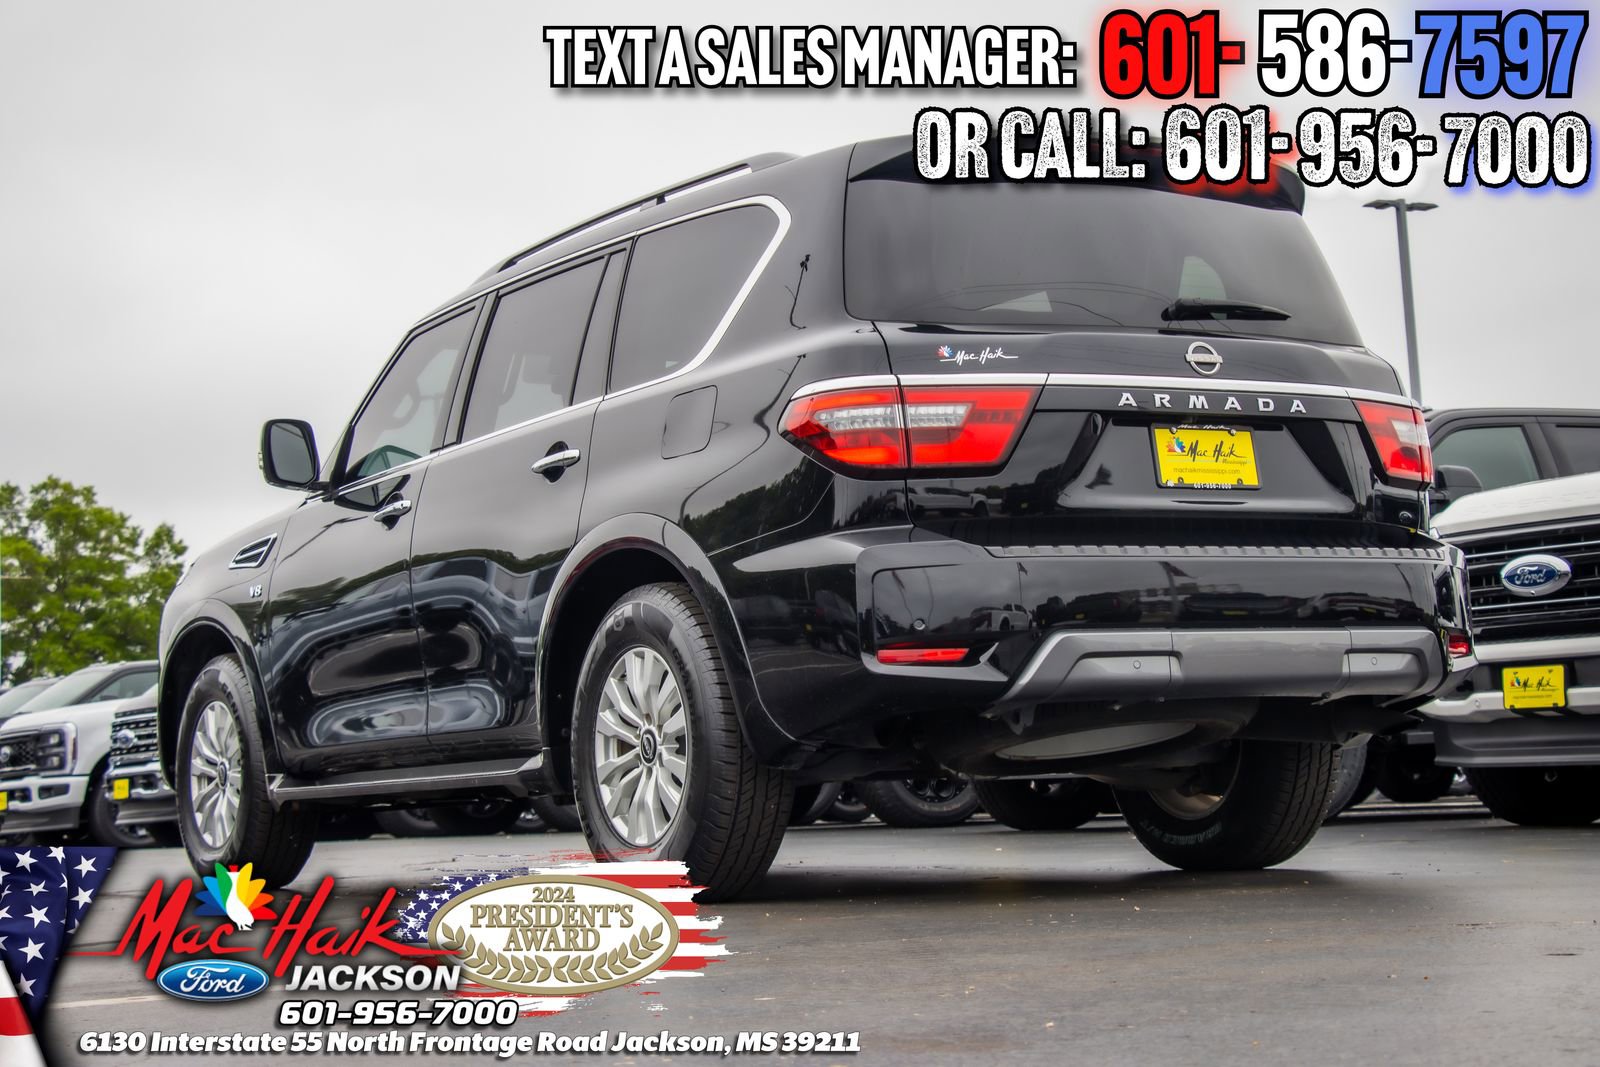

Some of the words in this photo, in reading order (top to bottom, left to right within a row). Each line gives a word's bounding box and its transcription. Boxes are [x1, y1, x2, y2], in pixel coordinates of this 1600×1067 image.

[940, 350, 979, 366] Mac
[979, 346, 1019, 365] Haik
[1118, 391, 1308, 414] ARMADA
[1186, 440, 1209, 463] Mac
[1212, 440, 1248, 463] Haik
[1514, 565, 1547, 585] Ford
